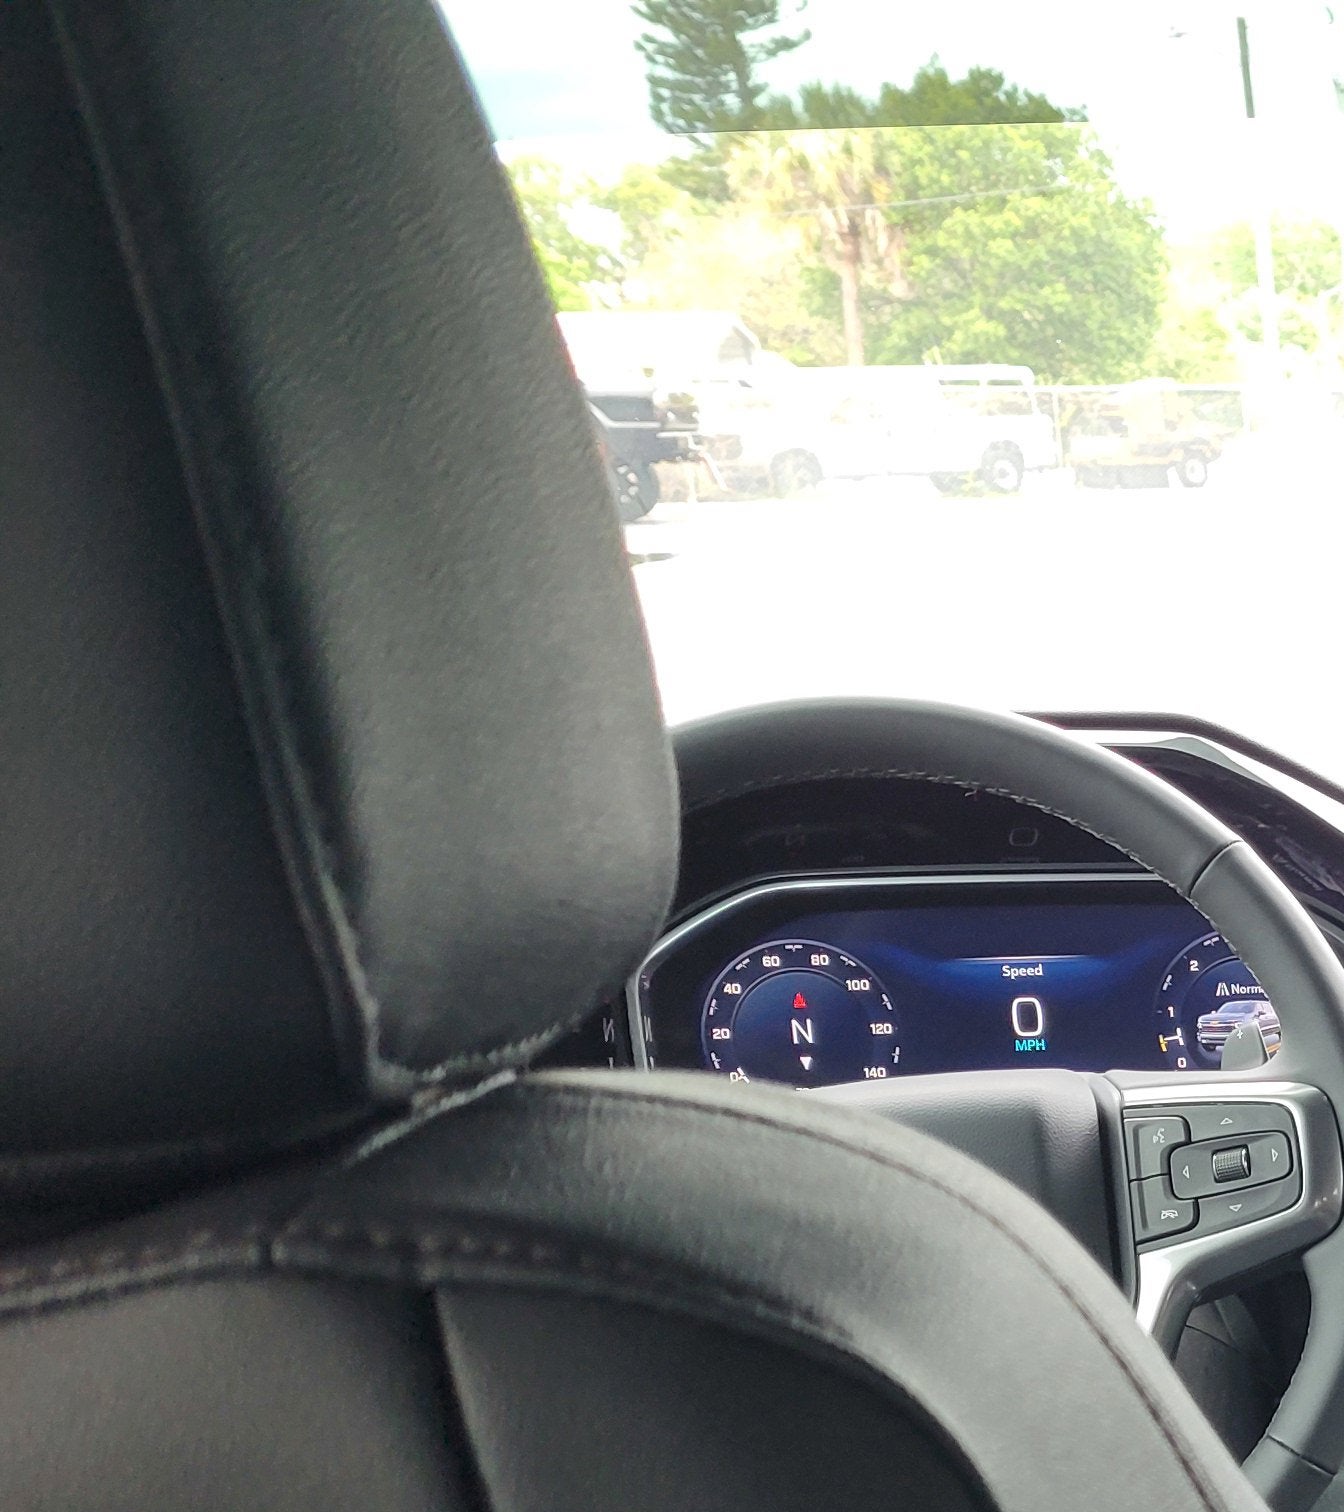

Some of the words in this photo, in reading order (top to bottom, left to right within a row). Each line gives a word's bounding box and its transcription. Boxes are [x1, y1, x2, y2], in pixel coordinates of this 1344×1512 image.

[762, 955, 780, 967] 60
[810, 954, 829, 966] 80
[1189, 960, 1199, 972] 2
[1002, 963, 1043, 980] Speed
[723, 983, 742, 995] 40
[846, 979, 870, 991] 100
[1011, 996, 1043, 1037] 0
[1167, 1006, 1175, 1018] 1
[712, 1028, 730, 1039] 20
[790, 1018, 815, 1045] N
[870, 1023, 892, 1035] 120
[1015, 1039, 1046, 1051] MPH
[1177, 1057, 1187, 1068] 0
[863, 1067, 886, 1078] 140
